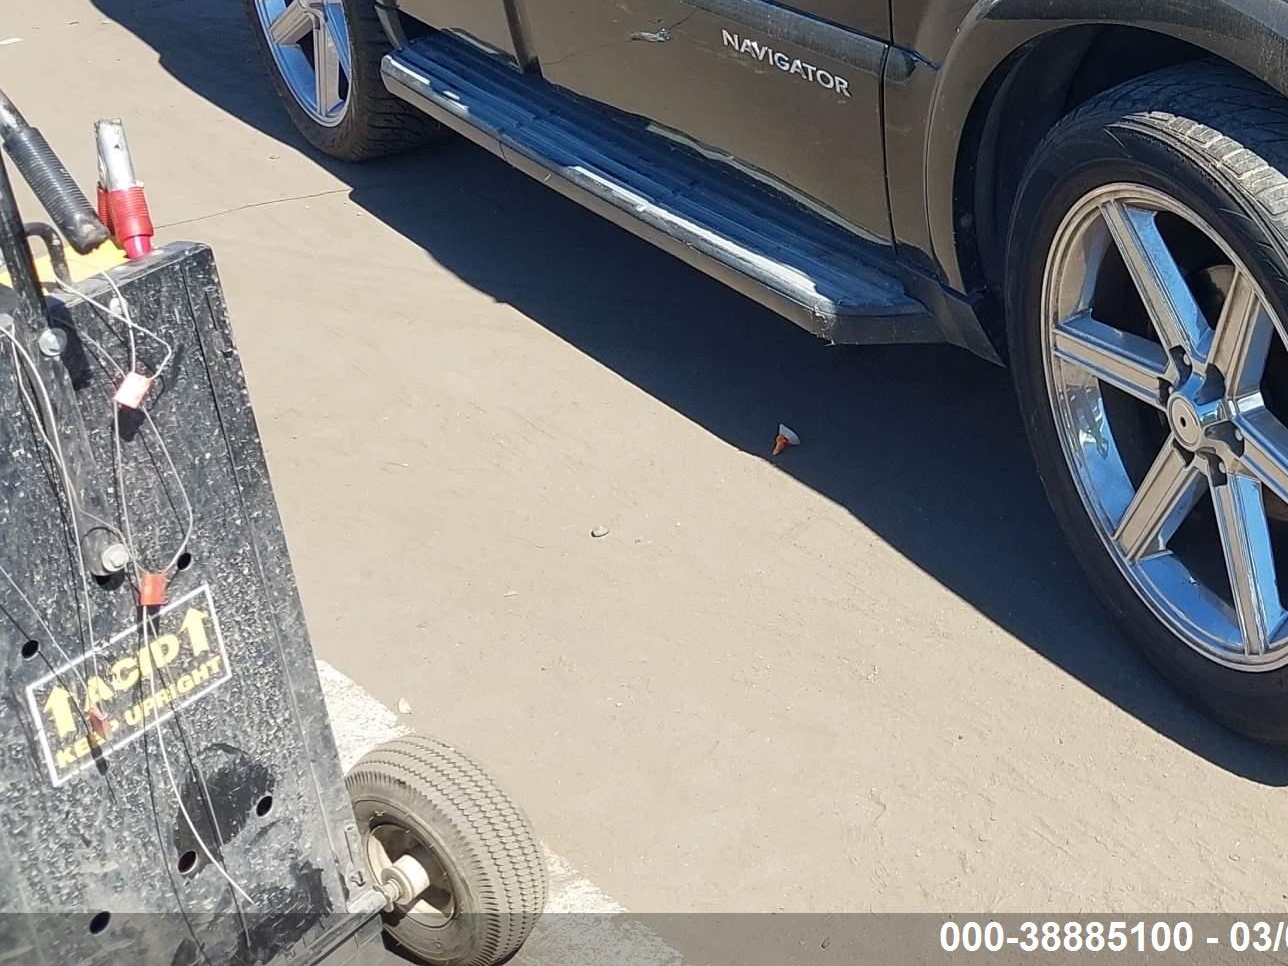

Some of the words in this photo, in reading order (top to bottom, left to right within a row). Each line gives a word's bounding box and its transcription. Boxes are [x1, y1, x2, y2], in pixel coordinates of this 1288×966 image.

[721, 29, 852, 97] NAVIGATOR
[83, 634, 181, 713] ACID
[124, 655, 222, 726] UPRIGHT
